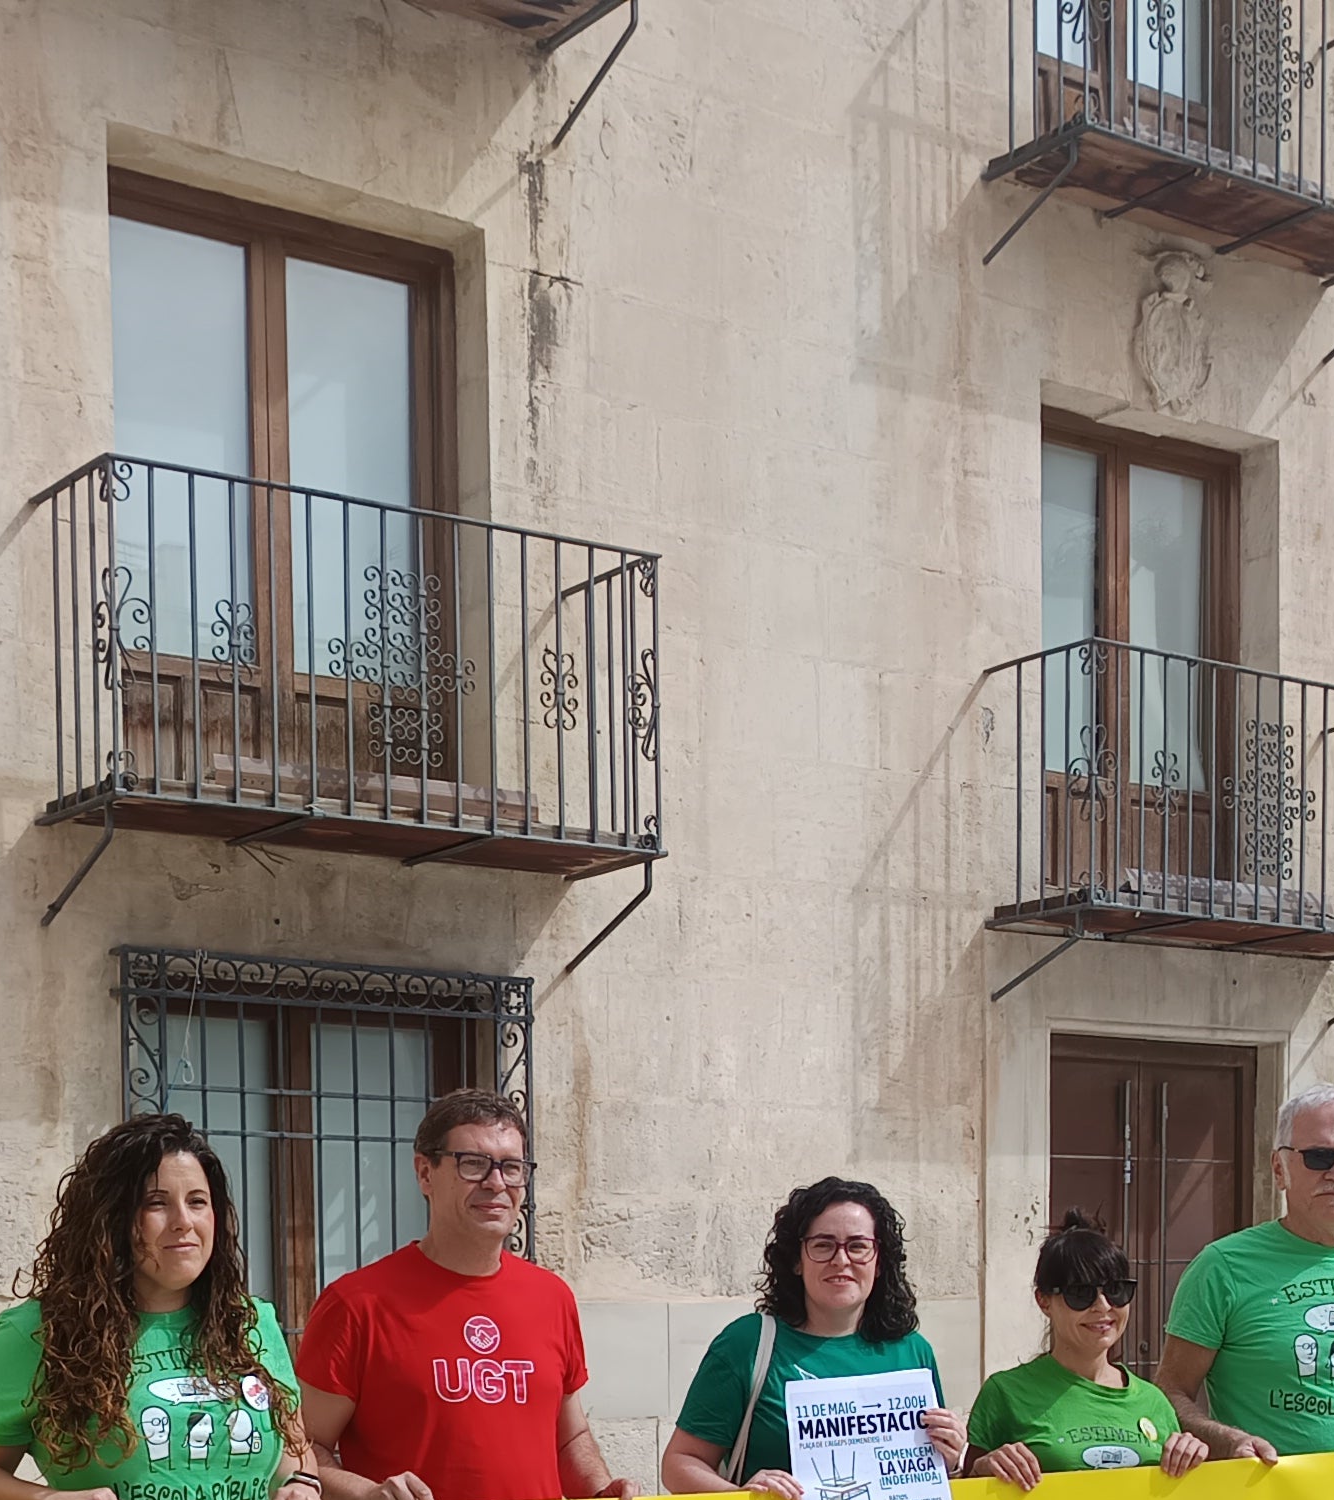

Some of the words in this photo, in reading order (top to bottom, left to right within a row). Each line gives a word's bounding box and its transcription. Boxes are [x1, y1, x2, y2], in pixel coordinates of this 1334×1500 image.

[433, 1358, 535, 1404] UGT
[795, 1406, 809, 1418] 11
[812, 1404, 827, 1417] DE
[828, 1401, 857, 1416] MAIG
[877, 1446, 933, 1461] COMENCEM
[879, 1461, 897, 1476] LA
[898, 1457, 937, 1474] VAGA
[881, 1472, 939, 1486] INDEFINIDA
